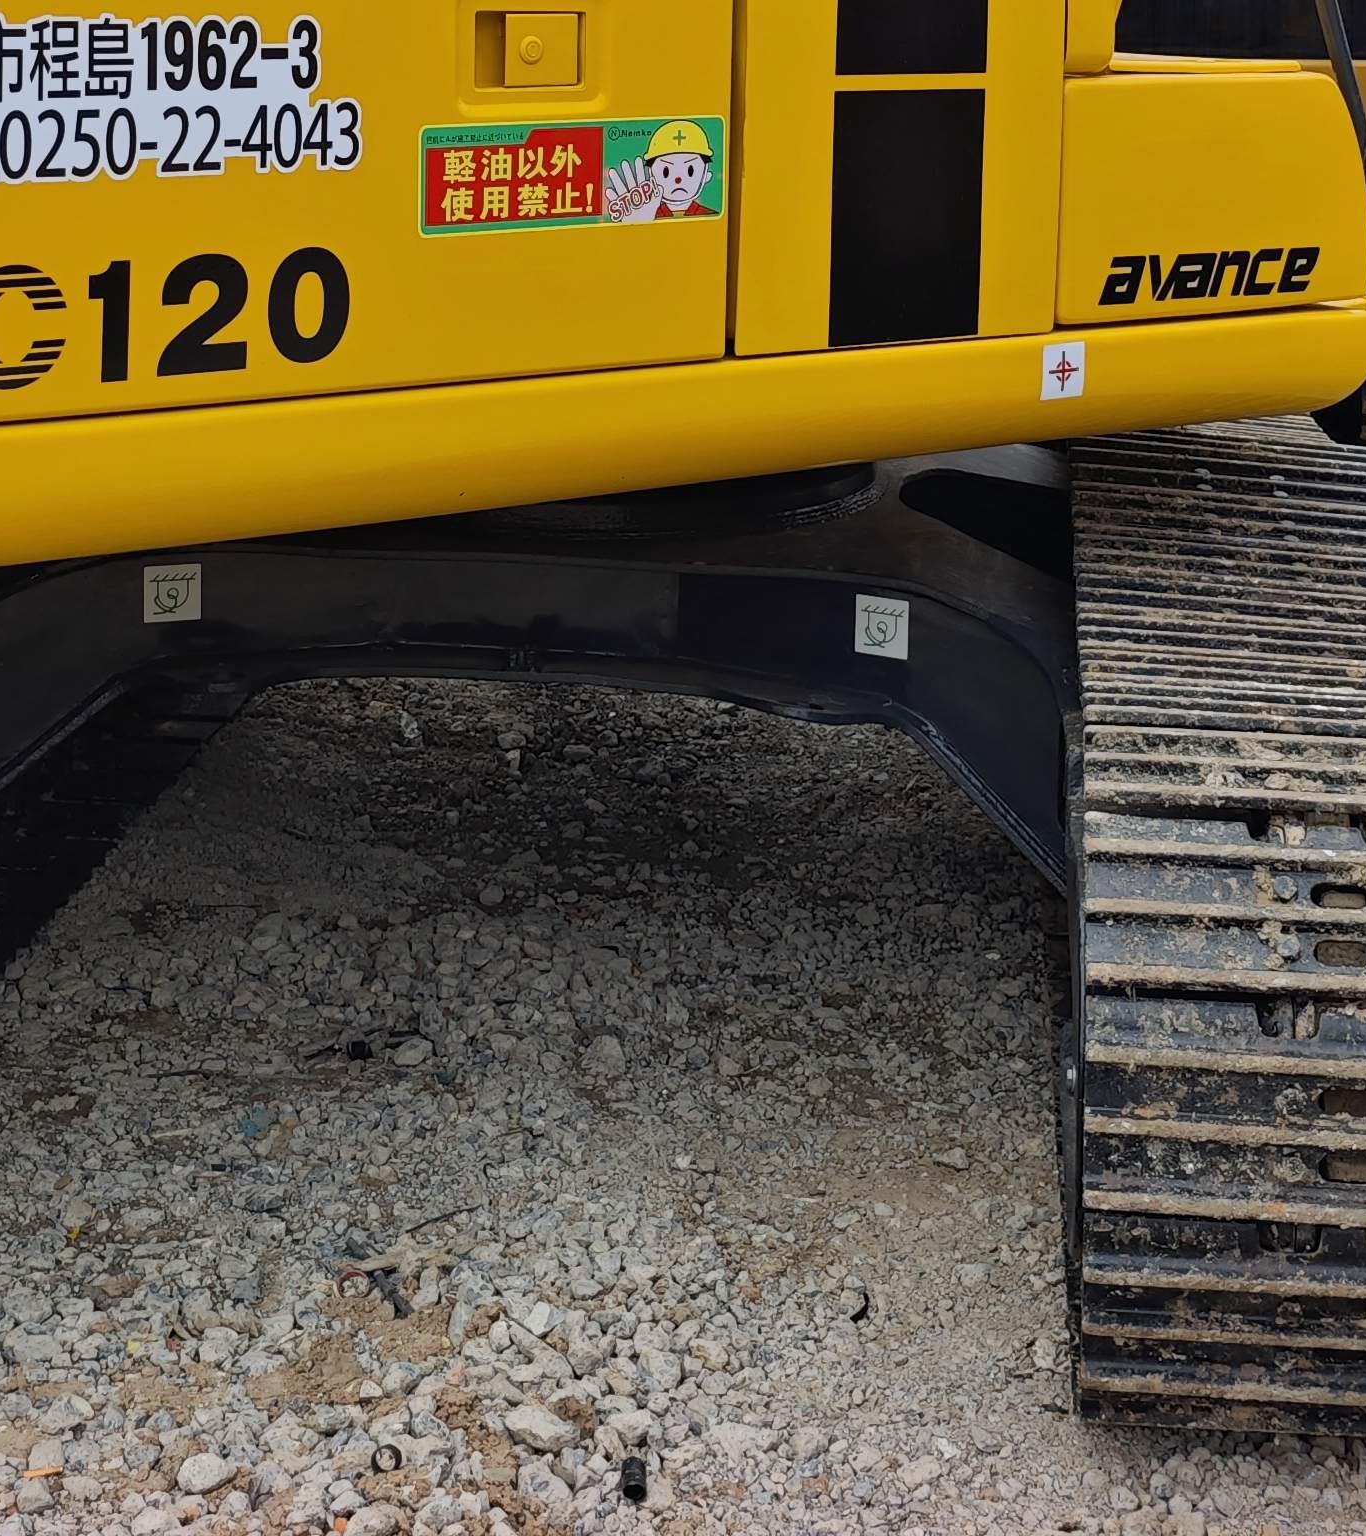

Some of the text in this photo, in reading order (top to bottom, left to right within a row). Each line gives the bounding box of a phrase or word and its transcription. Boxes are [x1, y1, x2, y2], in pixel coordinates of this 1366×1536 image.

[443, 144, 582, 184] 軽油以外
[441, 182, 594, 222] 使用禁止!
[609, 176, 660, 222] STOP!
